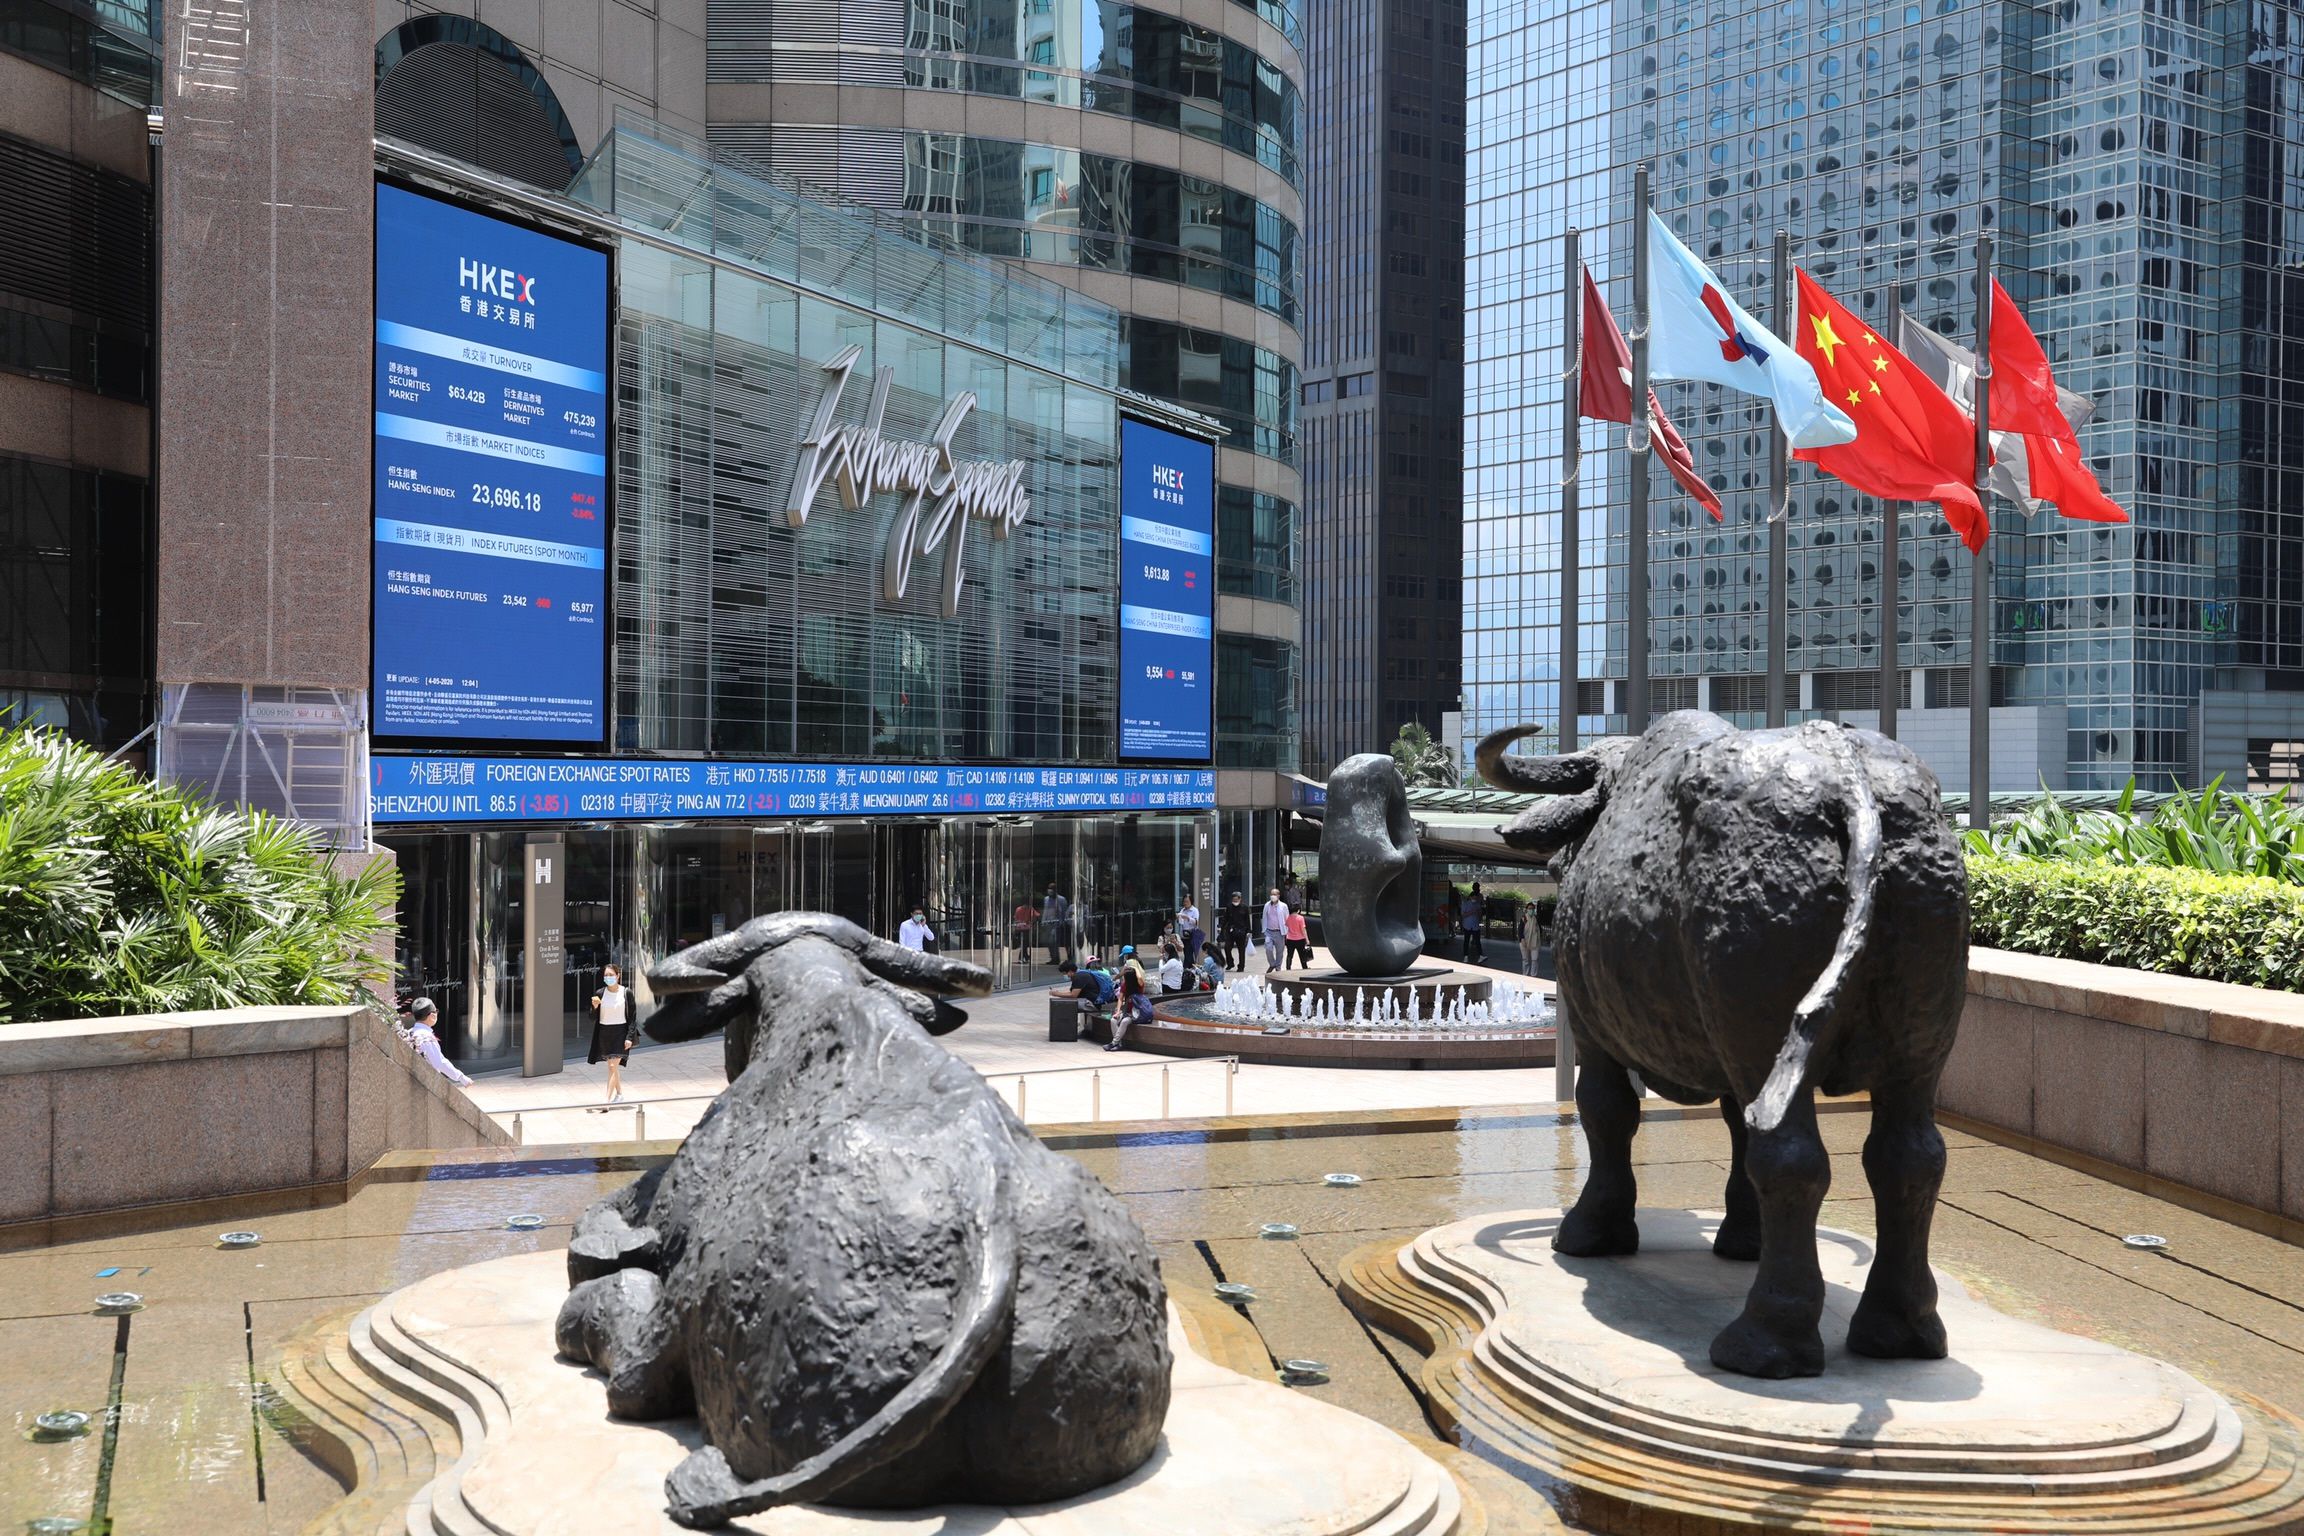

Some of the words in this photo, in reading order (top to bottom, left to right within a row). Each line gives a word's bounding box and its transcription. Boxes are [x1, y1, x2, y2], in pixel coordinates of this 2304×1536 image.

[460, 256, 535, 306] HKEX
[460, 296, 535, 330] 香港交易所
[490, 354, 532, 373] TURNOVER
[388, 376, 430, 392] SECURITIES
[388, 388, 419, 403] MARKET
[448, 384, 486, 404] $63.42B
[504, 400, 544, 416] DERIVATIVES
[504, 412, 530, 426] MARKET
[563, 410, 595, 428] 475,239
[481, 439, 513, 454] MARKET
[515, 444, 545, 460] INDICES
[1153, 464, 1183, 490] HKEX
[388, 480, 410, 491] HANG
[412, 483, 432, 495] SENG
[433, 486, 455, 498] INDEX
[472, 483, 541, 512] 23,696.18
[471, 538, 497, 550] INDEX
[499, 541, 533, 555] FUTURES
[1144, 565, 1170, 582] 9,613.88
[388, 584, 409, 594] HANG
[411, 586, 431, 596] SENG
[432, 588, 455, 599] INDEX
[456, 590, 487, 602] FUTURES
[503, 594, 527, 607] 23,542
[571, 602, 593, 614] 65,977
[1146, 665, 1163, 680] 9,554
[409, 761, 475, 786] 外匯現價
[487, 764, 546, 782] FOREIGN
[550, 765, 616, 782] EXCHANGE
[620, 766, 651, 782] SPOT
[654, 767, 690, 782] RATES
[706, 766, 729, 786] 港元
[734, 769, 755, 783] HKD
[759, 769, 788, 783] 7.7515
[798, 769, 826, 783] 7.7518
[859, 770, 877, 783] AUD
[880, 770, 905, 783] 0.6401
[914, 770, 938, 784] 0.6402
[946, 770, 964, 786] 加元
[967, 772, 982, 784] CAD
[985, 772, 1006, 784] 1.4106
[1014, 772, 1034, 784] 1.4109
[1059, 773, 1072, 784] EUR
[1075, 773, 1093, 784] 1.0941
[1139, 773, 1150, 785] JPY
[370, 795, 448, 814] SHENZHOU
[453, 795, 482, 812] INTL
[490, 795, 516, 812] 86.5
[581, 795, 615, 810] 02318
[620, 793, 672, 814] 中國平安
[677, 795, 703, 810] PING
[706, 795, 720, 809] AN
[726, 795, 745, 809] 77.2
[789, 794, 815, 809] 02319
[818, 792, 860, 812] 蒙牛乳業
[864, 794, 902, 807] MENGNIU
[904, 794, 929, 807] DAIRY
[932, 794, 948, 807] 26.6
[985, 793, 1005, 806] 02382
[1058, 793, 1079, 805] SUNNY
[1081, 793, 1106, 805] OPTICAL
